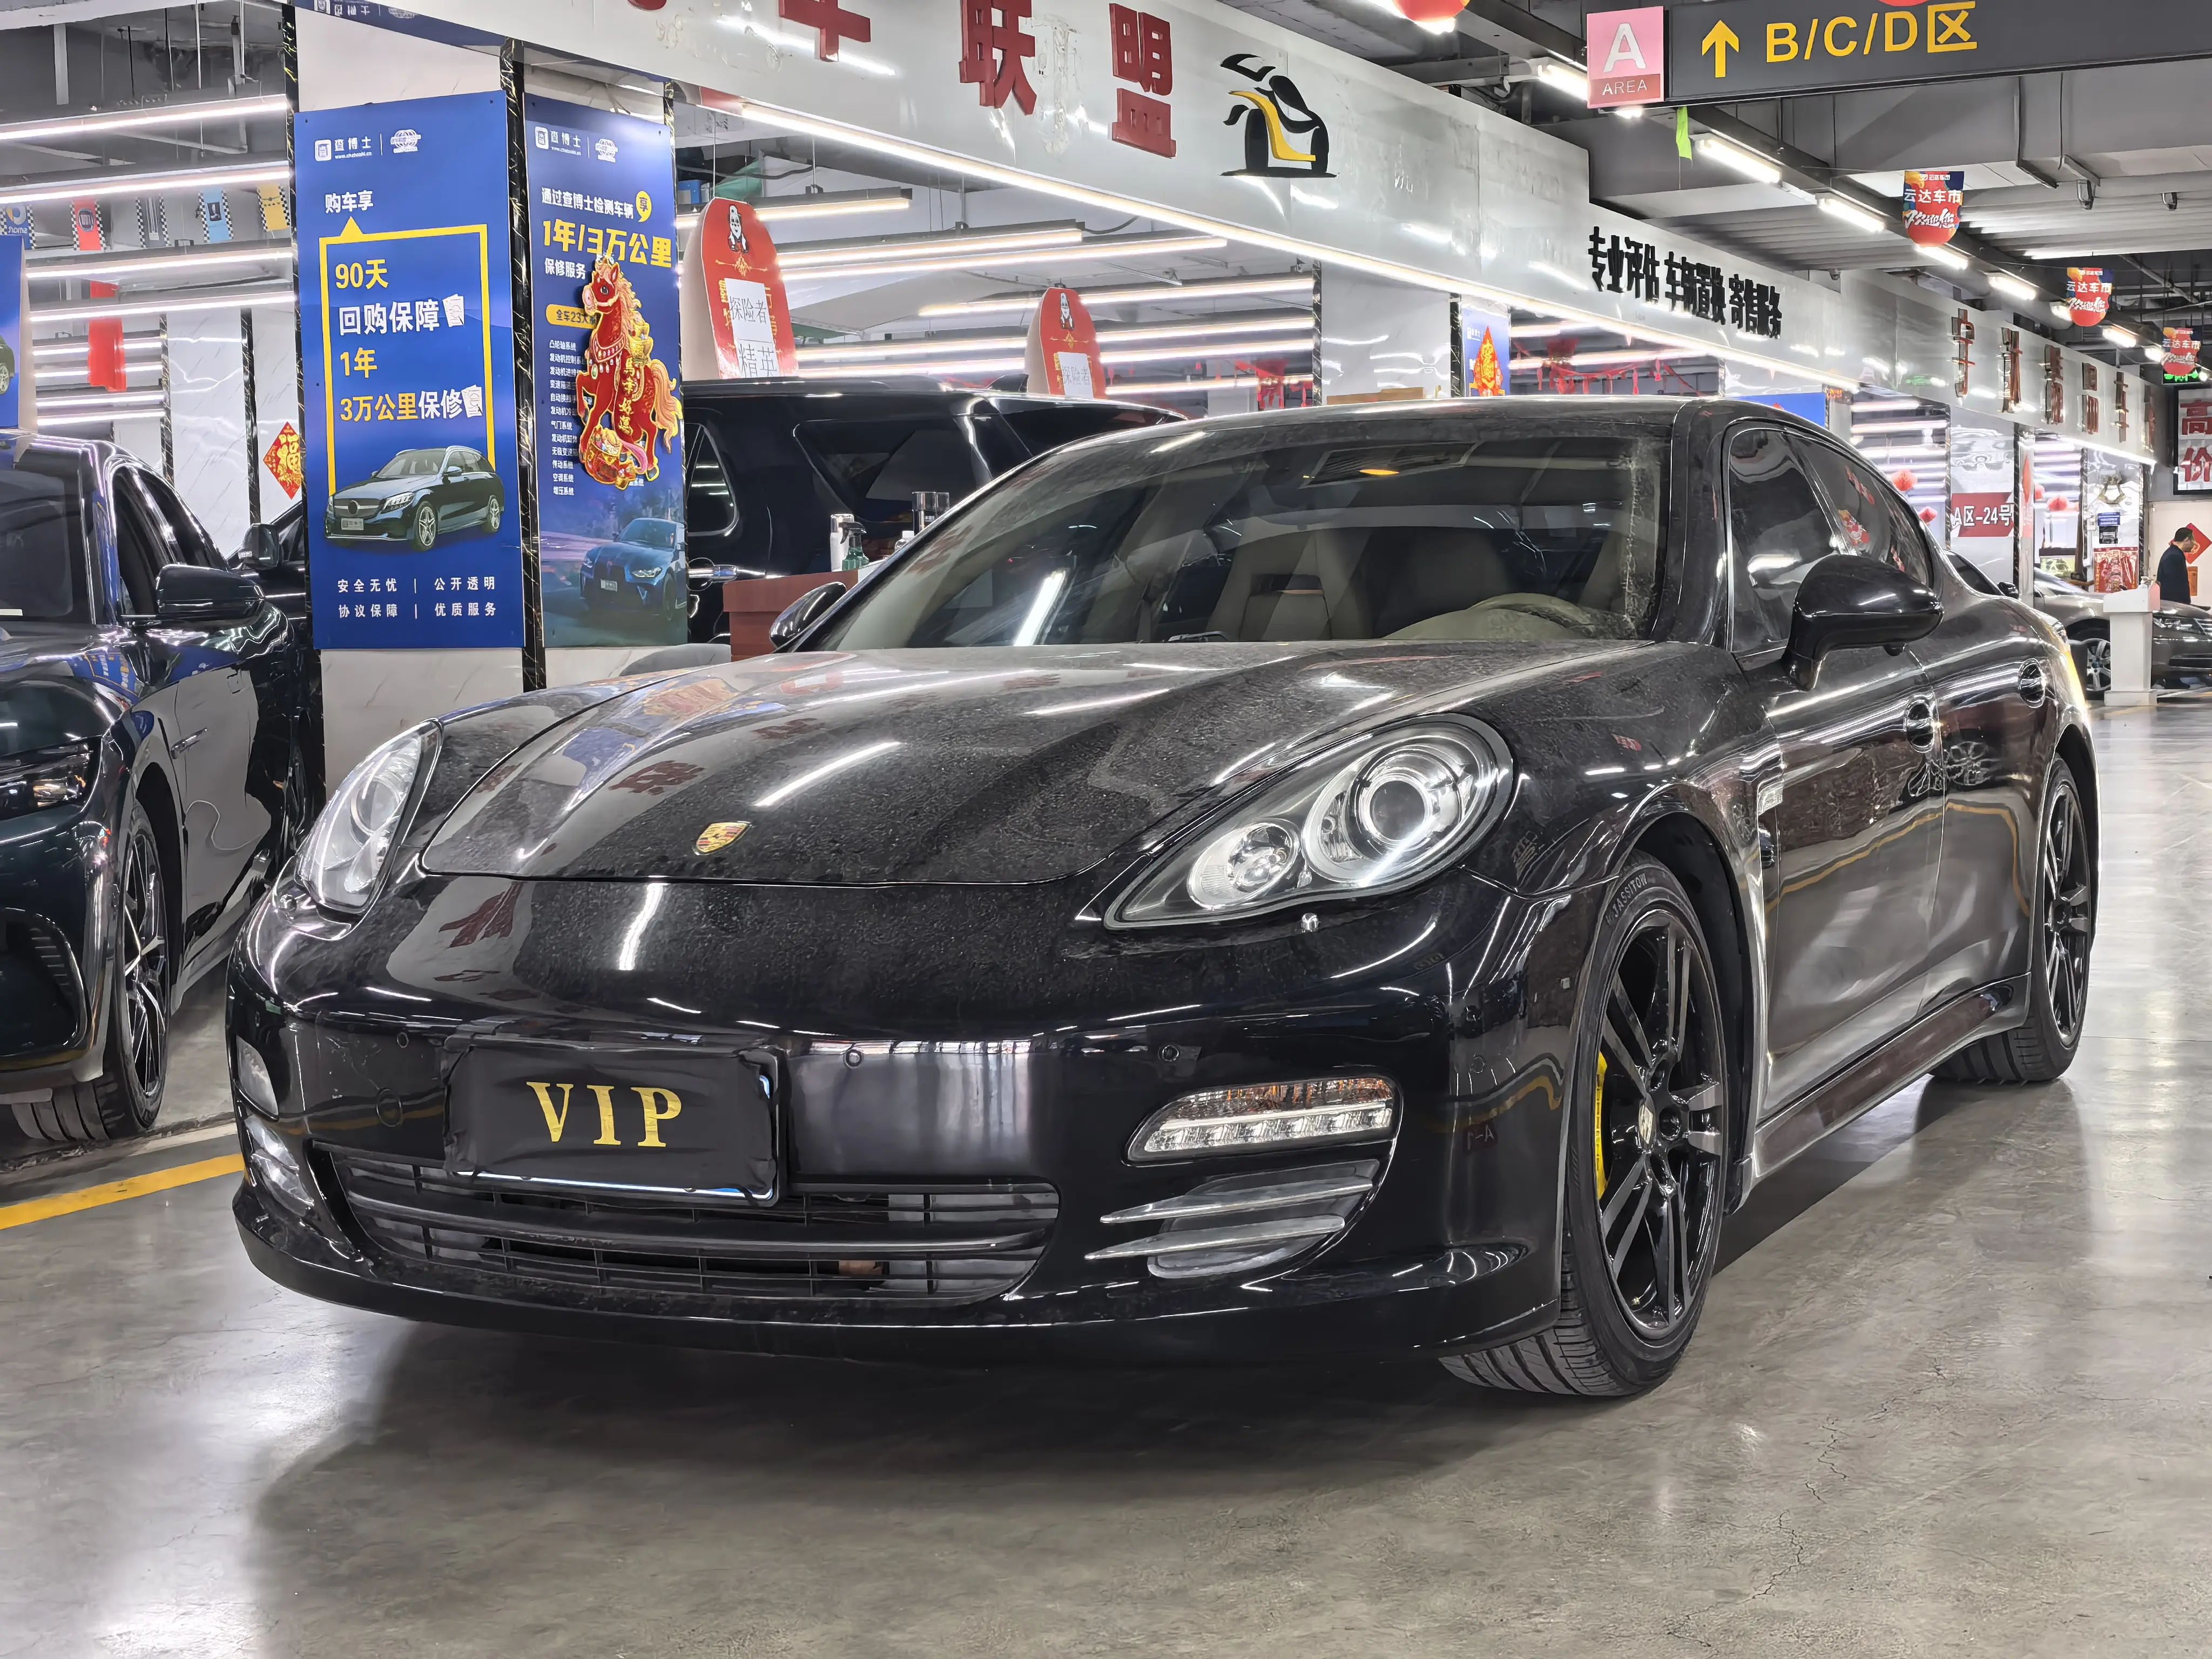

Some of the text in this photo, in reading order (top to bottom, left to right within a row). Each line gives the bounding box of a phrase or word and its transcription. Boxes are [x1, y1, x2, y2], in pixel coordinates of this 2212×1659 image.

[1766, 1, 1978, 63] B/C/D区
[1603, 23, 1646, 72] A
[1602, 79, 1647, 96] AREA
[334, 136, 372, 151] 查博士
[550, 131, 581, 148] 查博士
[325, 190, 374, 213] 购车享
[541, 187, 634, 219] 通过查博士检测车辆
[1904, 188, 1962, 204] 云达车市
[335, 259, 388, 289] 90天
[544, 258, 586, 280] 保修服务
[1588, 226, 1660, 304] 专业评估
[2066, 281, 2112, 295] 云达车市
[339, 299, 440, 335] 回购保障
[730, 297, 767, 324] 探险者
[340, 347, 377, 379] 1年
[738, 343, 779, 377] 精英
[1062, 365, 1090, 386] 探险者
[340, 389, 462, 422] 3万公里保修
[1953, 504, 2012, 527] A区-24号
[338, 576, 495, 593] 安全无忧 公开透明
[338, 602, 497, 618] 协议保障 优质服务
[526, 1081, 682, 1148] VIP
